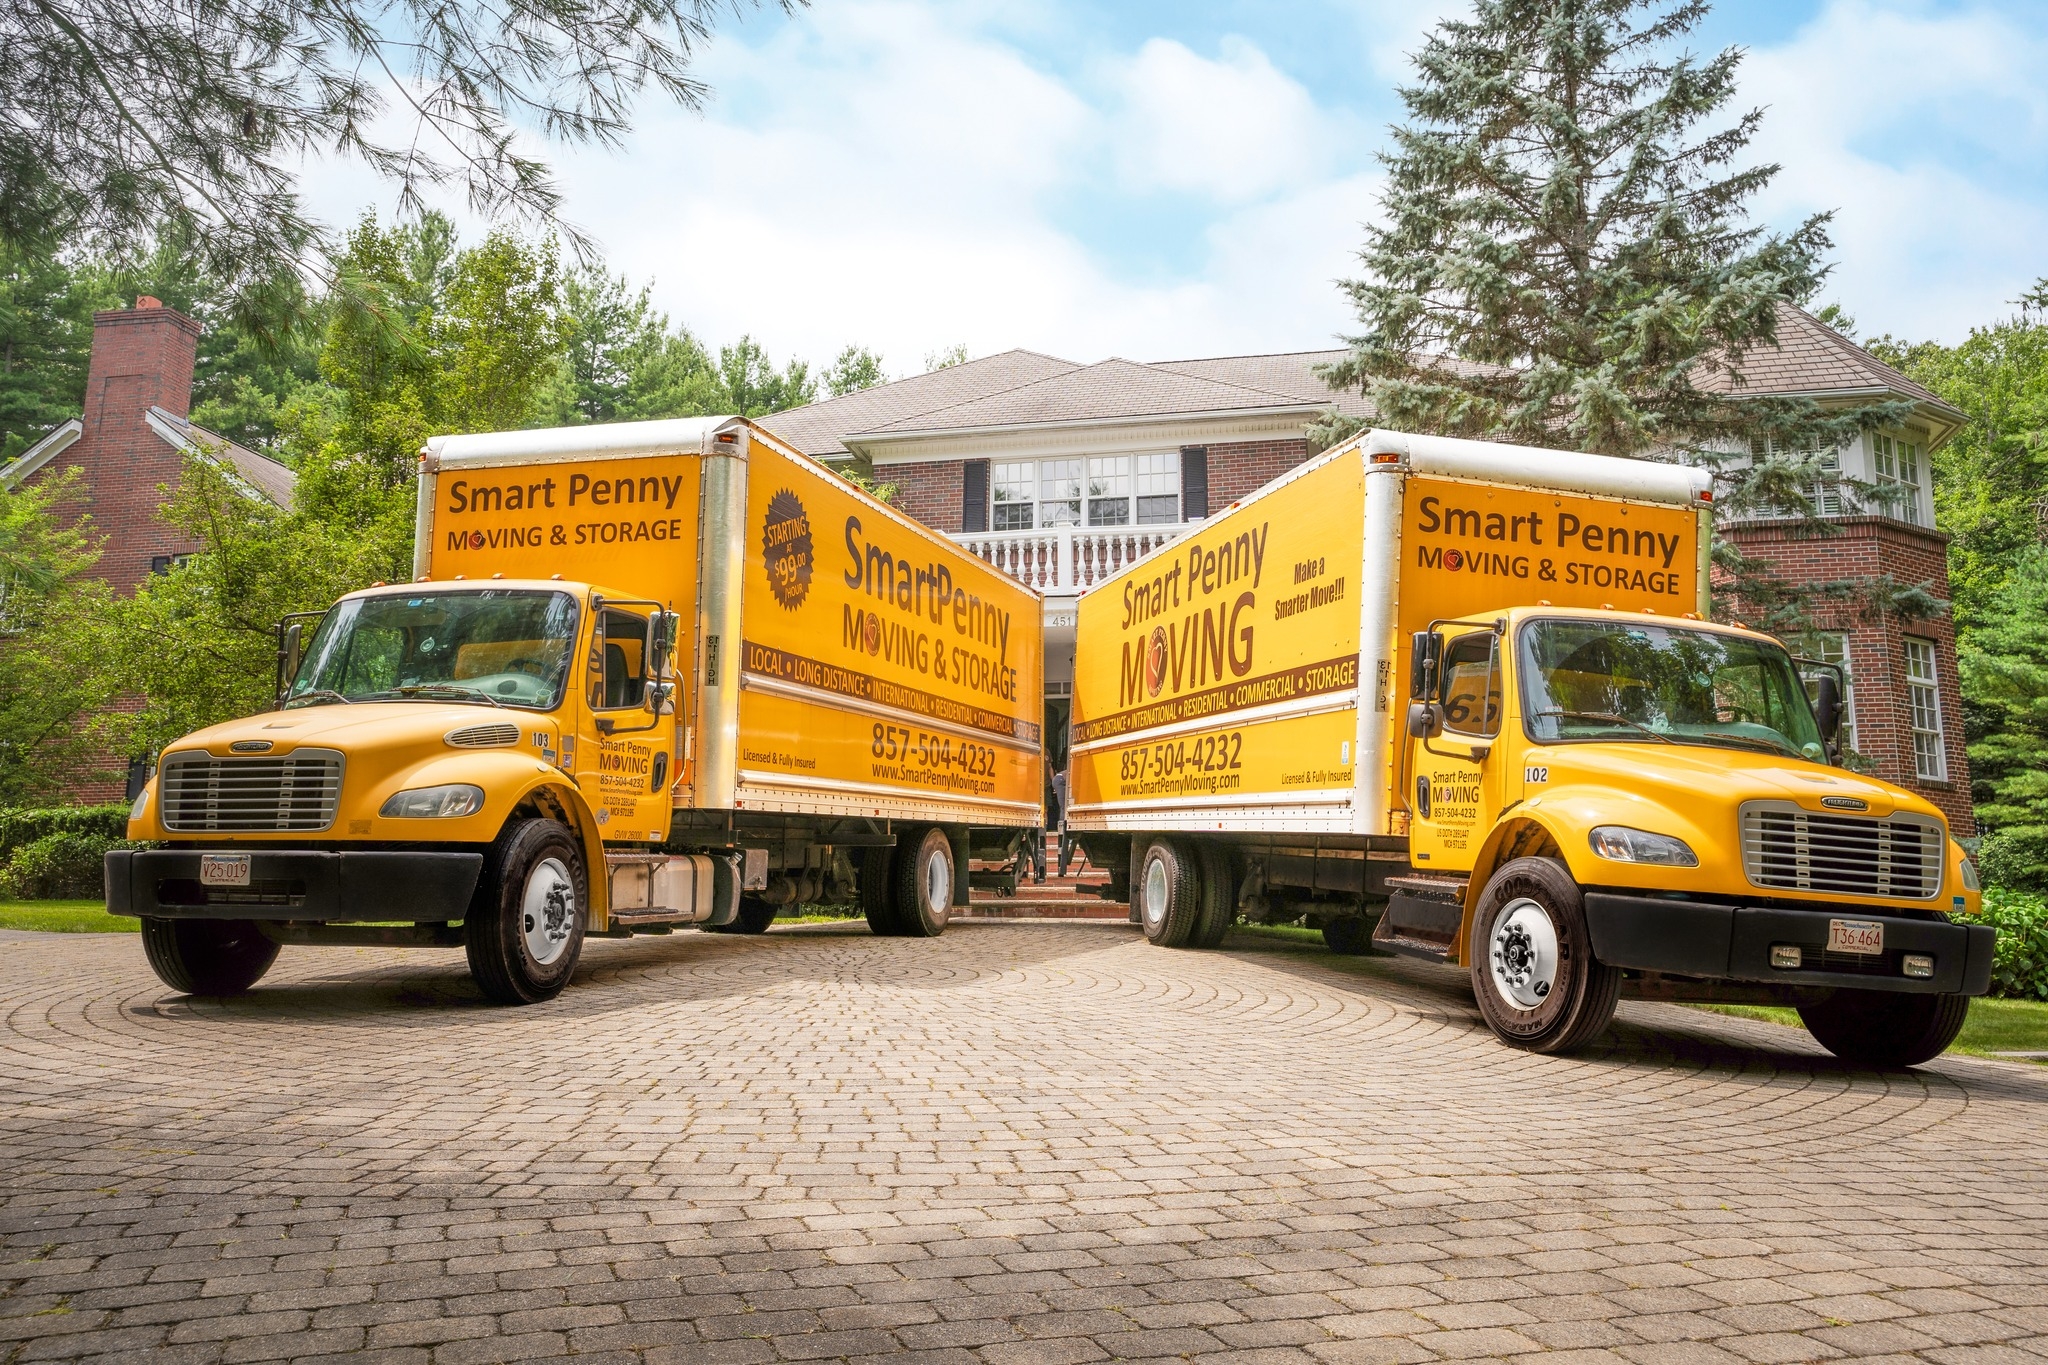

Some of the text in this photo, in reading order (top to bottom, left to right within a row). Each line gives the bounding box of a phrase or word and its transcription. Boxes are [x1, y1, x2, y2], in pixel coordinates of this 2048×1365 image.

[450, 473, 682, 513] Smart Penny
[447, 519, 681, 551] MOVING & STORAGE
[768, 516, 806, 548] STARTING
[1418, 496, 1680, 568] Smart Penny
[786, 543, 792, 553] AT
[774, 552, 806, 586] $99.00
[1122, 522, 1268, 630] Smart Penny
[1294, 556, 1325, 585] Make a
[1418, 546, 1528, 579] MOVING
[1538, 558, 1558, 583] &
[1565, 562, 1680, 596] STORAGE
[1275, 577, 1344, 620] Smarter Move!!!
[1052, 616, 1071, 626] 451
[843, 604, 928, 674] MOVING
[934, 639, 947, 682] &
[952, 646, 1016, 702] STORAGE
[1120, 591, 1255, 708] MOVING
[750, 646, 1038, 740] LOCAL LONG DISTANCE INTERNATIONAL RESIDENTIAL COMMERCIAL STORAGE
[1073, 661, 1355, 741] LOCAL LONG DISTANCE INTERNATIONAL RESIDENTIAL COMMERCIAL STORAGE
[533, 732, 548, 747] 103
[600, 738, 652, 758] Smart Penny
[872, 723, 996, 778] 857-504-4232
[600, 754, 648, 774] MOVING
[744, 748, 816, 769] Licensed & Fully Insured
[1121, 732, 1242, 781] 857-504-4232
[600, 775, 644, 788] 857-504-4232
[872, 764, 995, 794] www.SmartPennyMoving.com
[1120, 772, 1240, 797] www.SmartPennyMoving.com
[1282, 768, 1352, 785] Licensed & Fully Insured
[1433, 770, 1483, 786] Smart Penny
[1526, 768, 1547, 782] 102
[1433, 786, 1479, 803] MOVING
[1434, 808, 1476, 818] 857-504-4232
